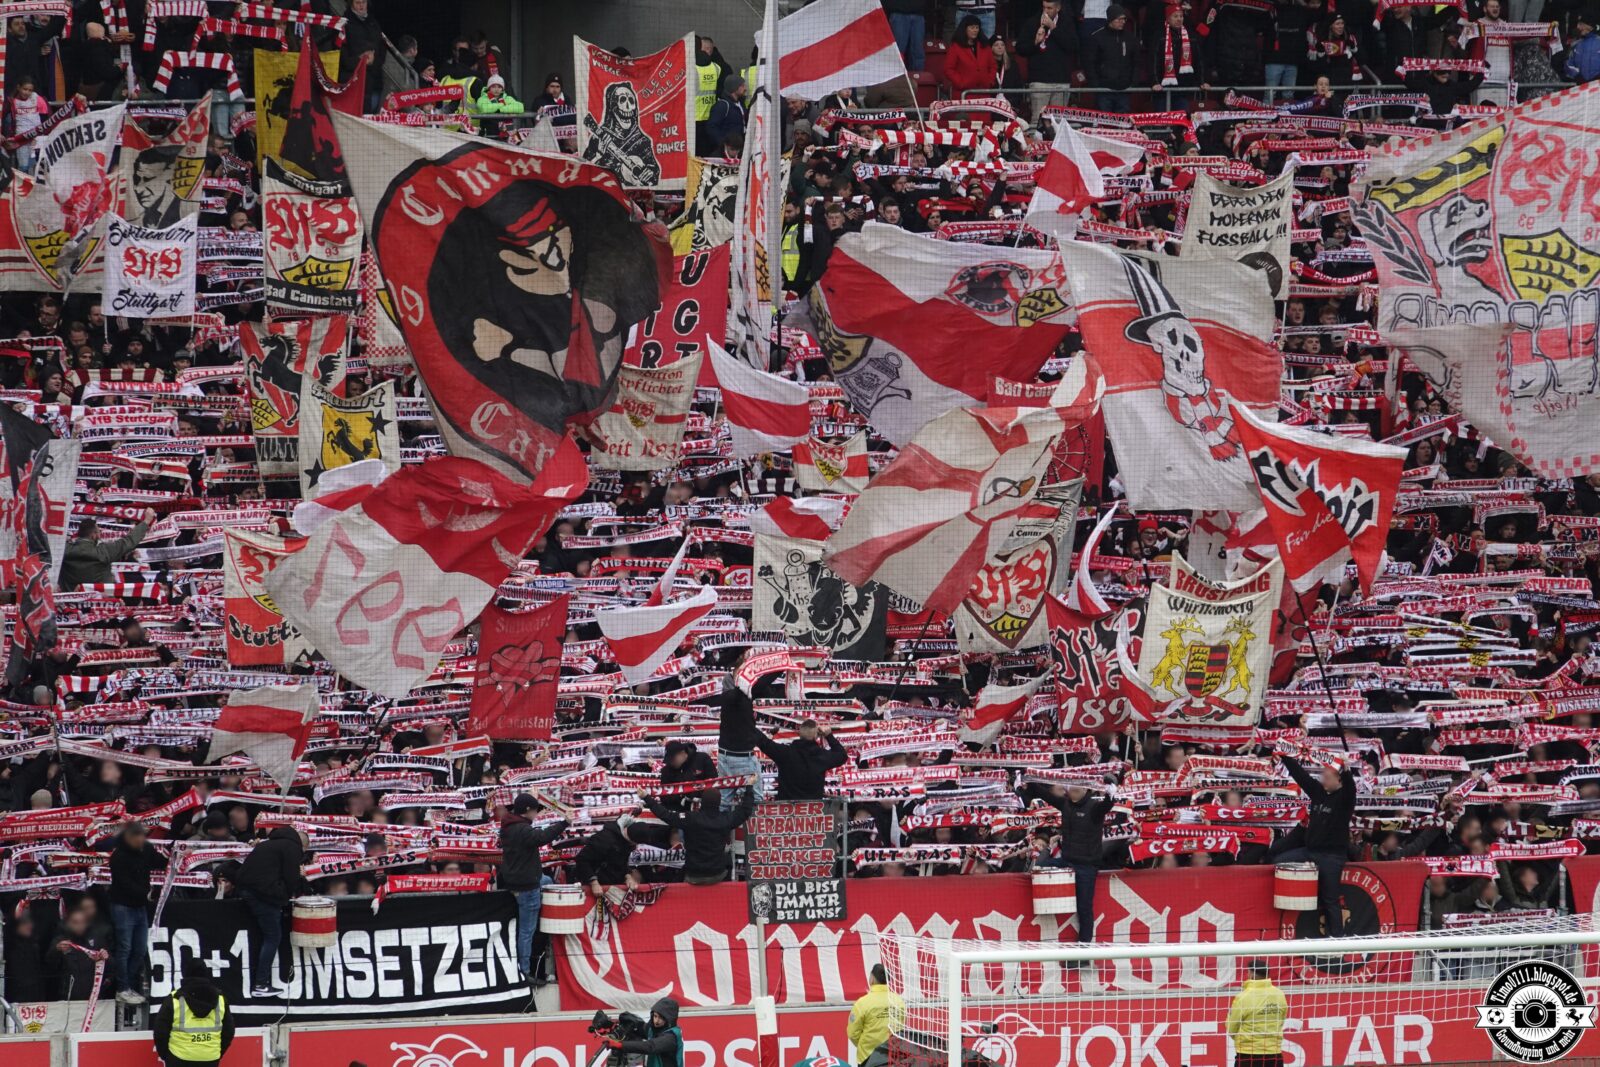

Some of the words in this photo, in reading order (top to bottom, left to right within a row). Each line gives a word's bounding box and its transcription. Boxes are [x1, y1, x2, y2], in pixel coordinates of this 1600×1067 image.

[1300, 150, 1372, 162] STUTTGART
[1209, 191, 1257, 208] GEGEN
[1260, 188, 1286, 205] DEN
[1209, 207, 1281, 227] MODERNEN
[109, 221, 163, 246] Sektion
[166, 227, 195, 244] 0711
[1196, 227, 1275, 247] FUSSBALL
[287, 252, 300, 262] 18
[324, 247, 339, 258] 93
[123, 246, 183, 280] VfB
[112, 288, 186, 316] Stuttgart
[100, 381, 184, 393] STUTTGART
[995, 377, 1021, 396] Bad
[87, 415, 112, 426] VfB
[115, 414, 175, 425] Stuttgart
[174, 511, 237, 523] CANNSTATTER
[1285, 529, 1311, 554] Für
[980, 609, 993, 619] 18
[1019, 604, 1032, 614] 93
[1167, 595, 1254, 617] Württemberg
[1460, 689, 1487, 699] WIR
[1490, 689, 1521, 700] SIND
[1542, 690, 1564, 700] VfB
[1202, 757, 1234, 770] SIND
[1400, 756, 1417, 765] VfB
[1419, 757, 1462, 768] Stuttgart
[923, 767, 958, 778] KURVE
[755, 801, 825, 816] JEDER
[1217, 808, 1246, 819] CC
[1274, 807, 1301, 818] 97
[13, 825, 37, 834] JAHRE
[38, 823, 84, 833] KREUZEICHE
[747, 814, 835, 834] VERBANNTE
[1006, 816, 1040, 827] COMM
[755, 833, 828, 848] KEHRT
[1149, 839, 1177, 854] CC
[1203, 836, 1231, 850] 97
[378, 851, 417, 867] RAS
[864, 850, 901, 862] ULT
[918, 850, 951, 861] RAS
[750, 862, 833, 880] ZURÜCK
[416, 877, 483, 887] STUTTGART
[775, 881, 798, 895] DU
[804, 879, 840, 894] BIST
[775, 893, 841, 909] IMMER
[775, 908, 800, 921] BEI
[804, 906, 841, 919] UNS!
[563, 875, 1236, 1011] Commando
[1056, 1014, 1436, 1067] JOKESTAR
